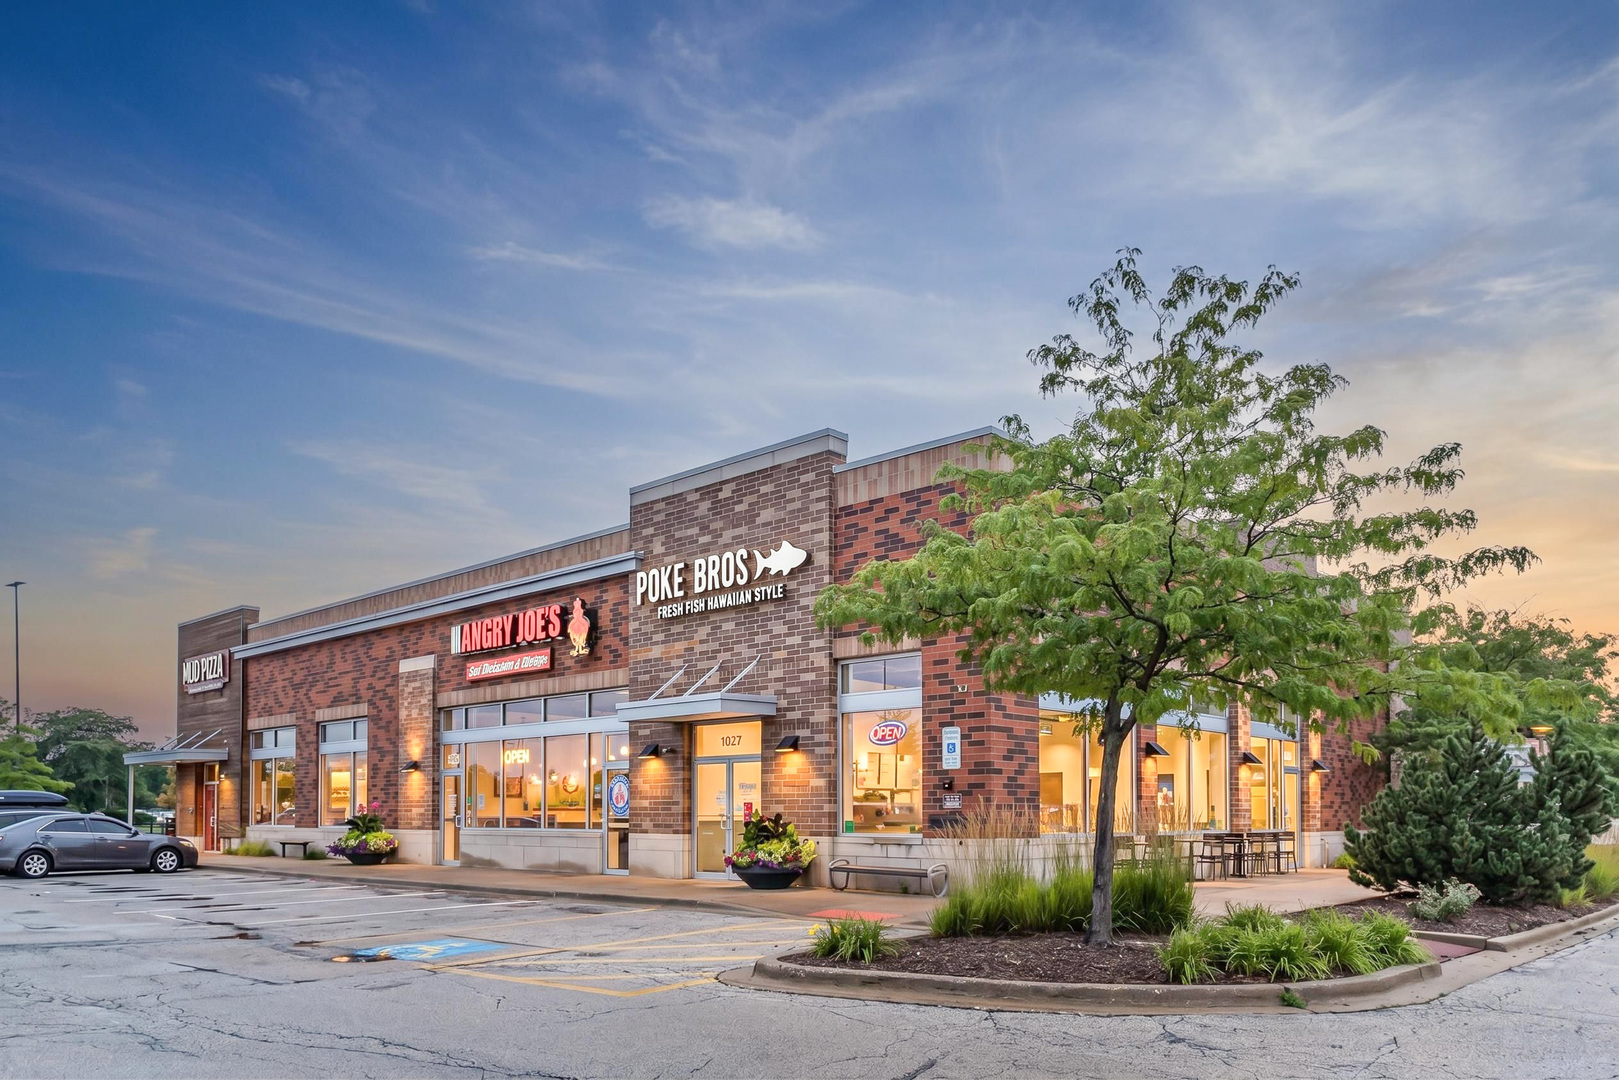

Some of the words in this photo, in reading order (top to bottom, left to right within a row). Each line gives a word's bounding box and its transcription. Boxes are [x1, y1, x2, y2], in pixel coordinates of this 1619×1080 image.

[636, 562, 685, 605] POKE
[694, 548, 748, 594] BROS
[657, 602, 684, 619] FRESH
[685, 598, 705, 615] FISH
[707, 590, 751, 611] HAWAIIAN
[754, 584, 784, 602] STYLE
[461, 614, 513, 653] ANGRY
[516, 604, 561, 643] JOE'S
[183, 660, 200, 685] MUD
[201, 653, 223, 681] PIZZA
[721, 735, 742, 747] 1027
[872, 726, 901, 740] OPEN
[504, 749, 529, 764] OPEN
